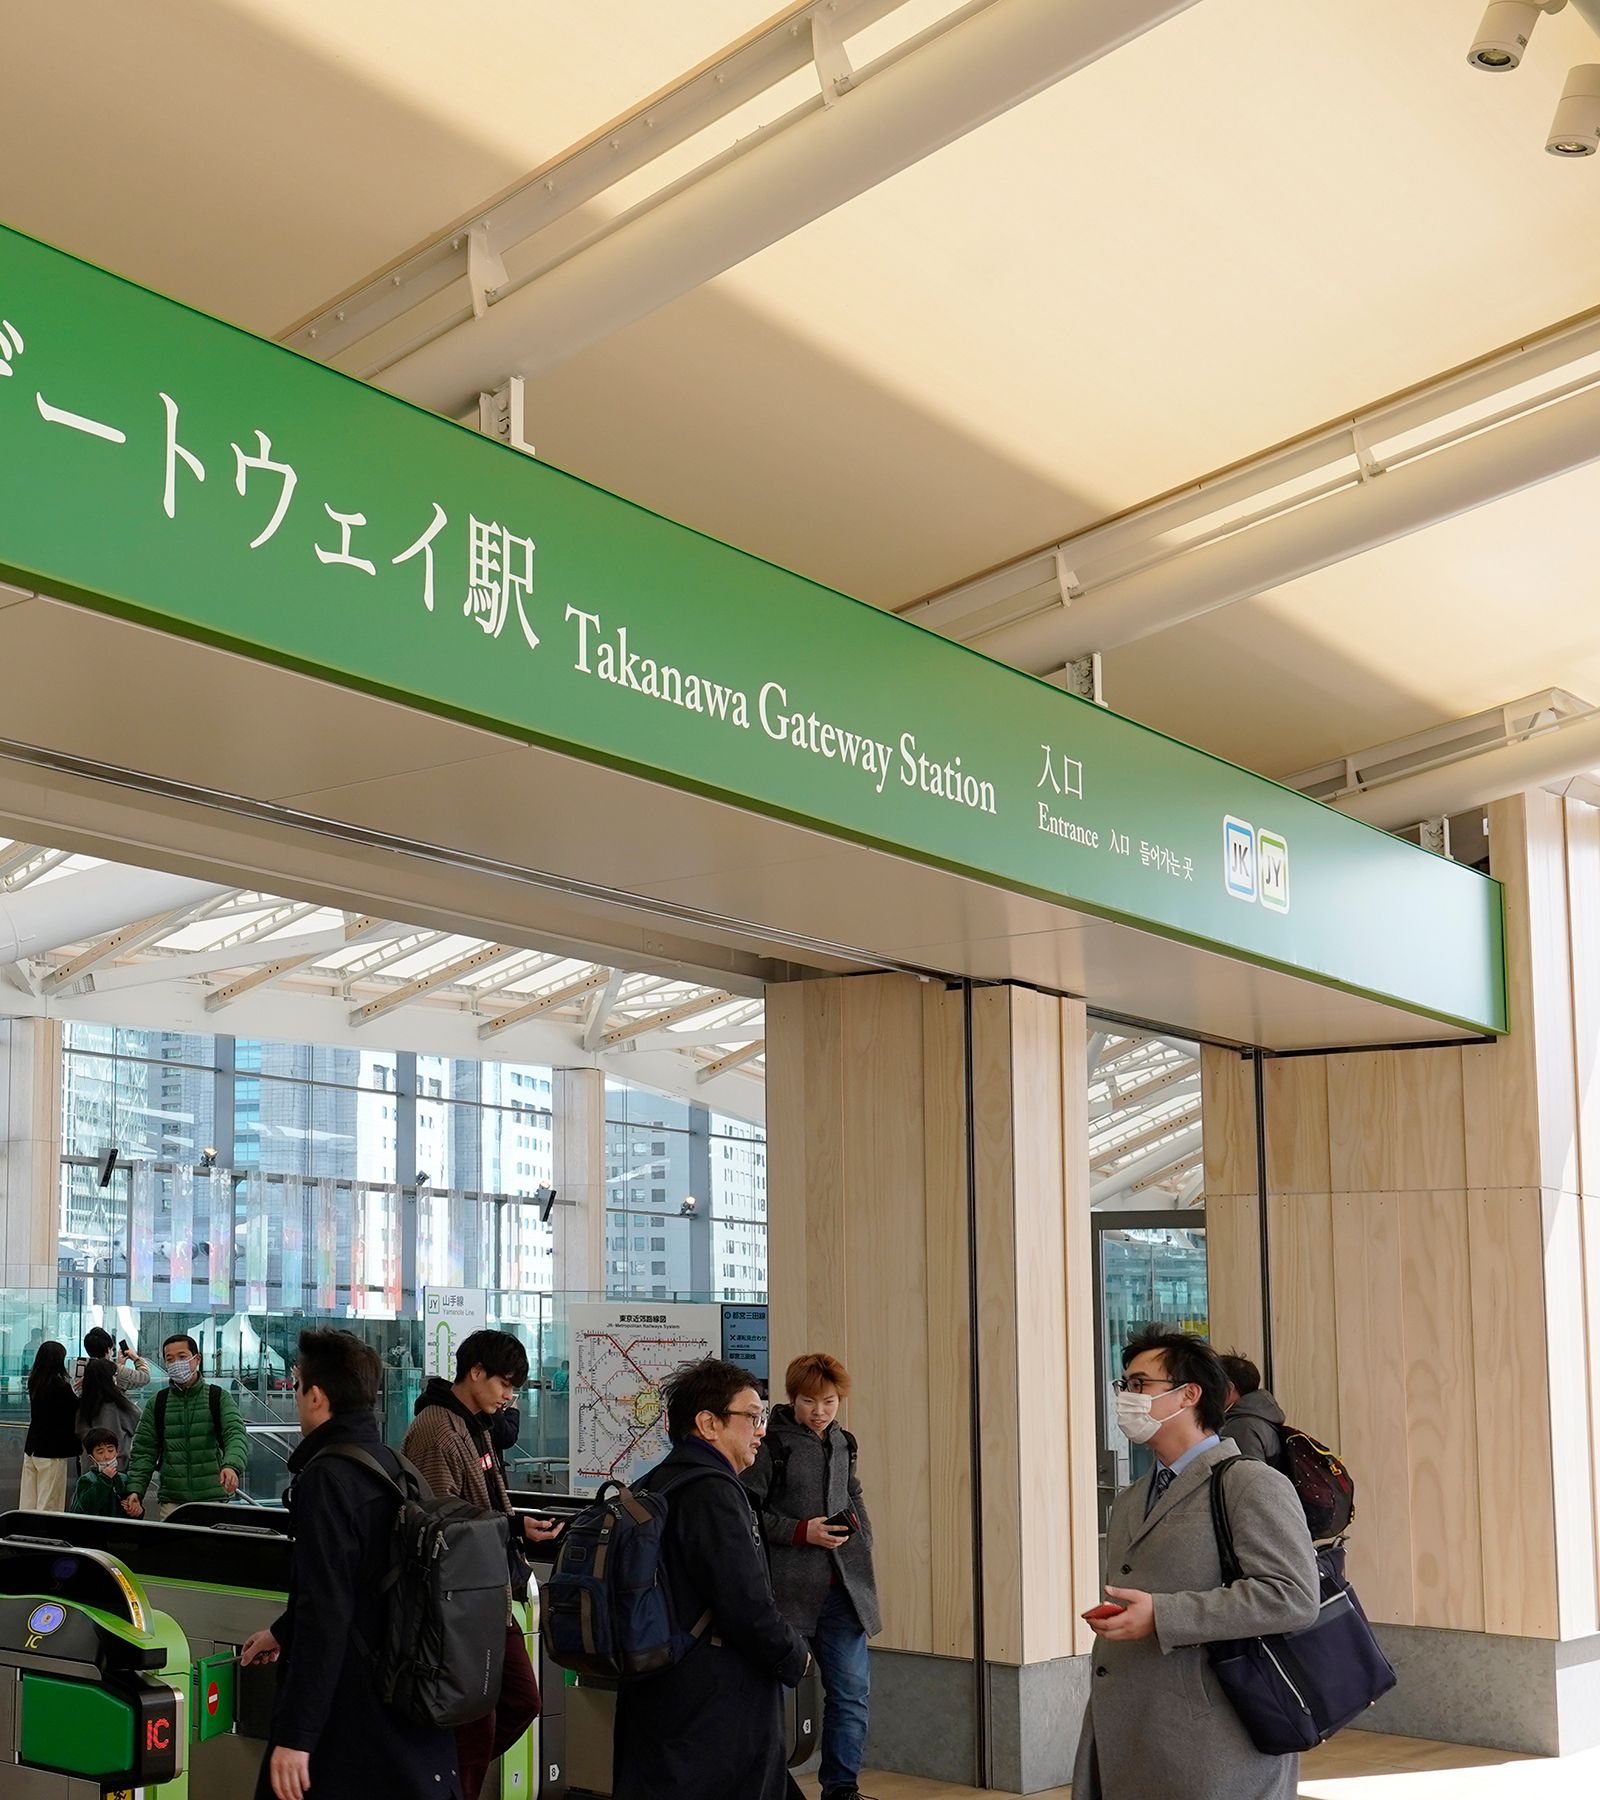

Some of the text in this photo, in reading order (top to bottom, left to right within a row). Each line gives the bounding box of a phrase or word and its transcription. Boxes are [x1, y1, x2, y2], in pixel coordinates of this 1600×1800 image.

[564, 603, 997, 814] Takanawa Gateway Station
[1036, 744, 1083, 800] 入口
[1037, 801, 1099, 849] Entrance
[1109, 829, 1130, 856] 入口
[1232, 842, 1250, 878] JK
[1264, 857, 1281, 887] JY
[429, 1299, 438, 1309] JY
[442, 1294, 464, 1307] 山手線
[24, 1634, 43, 1649] IC
[146, 1718, 170, 1750] IC
[551, 1767, 556, 1777] 8
